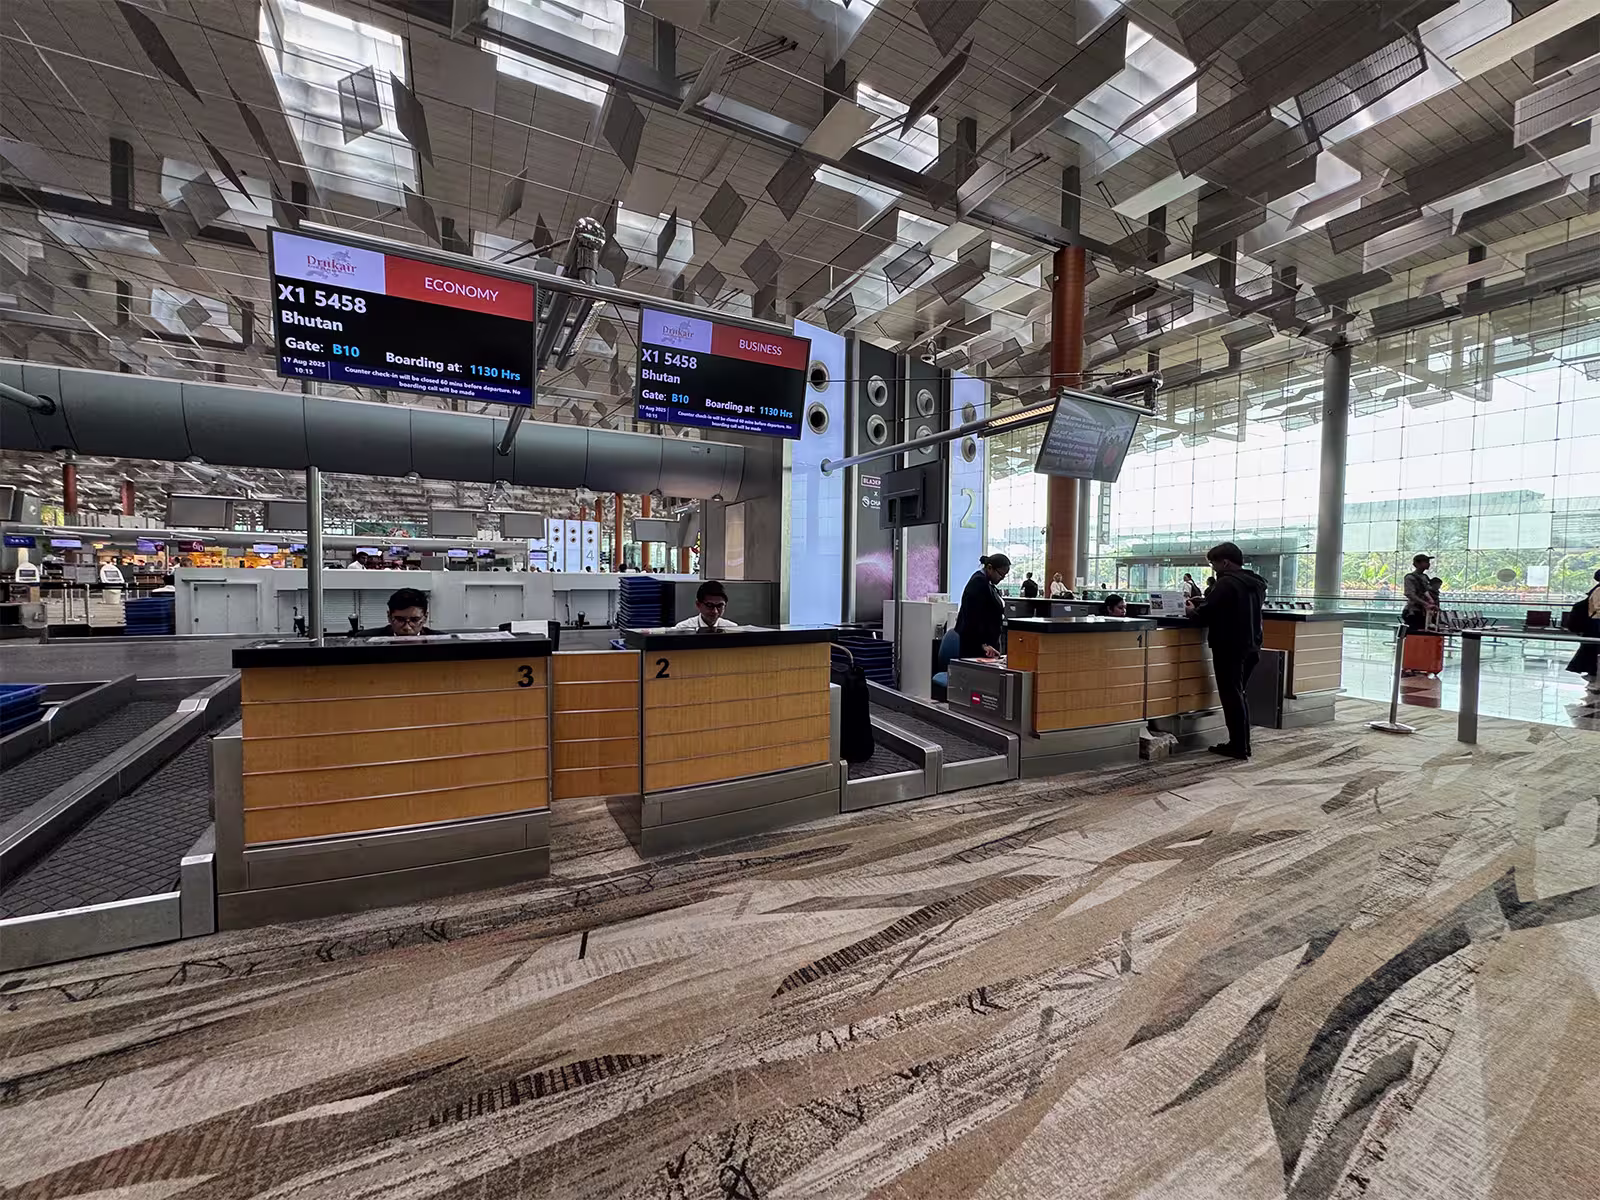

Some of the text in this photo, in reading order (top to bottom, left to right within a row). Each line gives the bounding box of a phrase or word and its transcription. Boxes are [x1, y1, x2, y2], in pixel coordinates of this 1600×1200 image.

[307, 254, 357, 273] Drukair
[278, 283, 367, 314] X1 5458
[424, 277, 498, 302] ECONOMY
[282, 310, 343, 332] Bhutan
[285, 337, 360, 358] Gate: B10
[739, 339, 783, 356] BUSINESS
[293, 358, 308, 366] Aug
[386, 352, 520, 380] Boarding at: 1130 Hrs
[642, 348, 698, 369] X1 5458
[344, 366, 370, 375] Counter
[372, 370, 398, 378] check-in
[483, 385, 512, 394] departure.
[399, 381, 426, 390] boarding
[642, 368, 680, 384] Bhutan
[642, 390, 690, 404] Gate: B10
[706, 398, 743, 414] Boarding
[760, 406, 778, 416] 1130
[780, 410, 793, 418] Hrs
[960, 488, 977, 528] 2
[586, 550, 594, 561] 4
[518, 665, 534, 687] 3
[656, 658, 670, 678] 2
